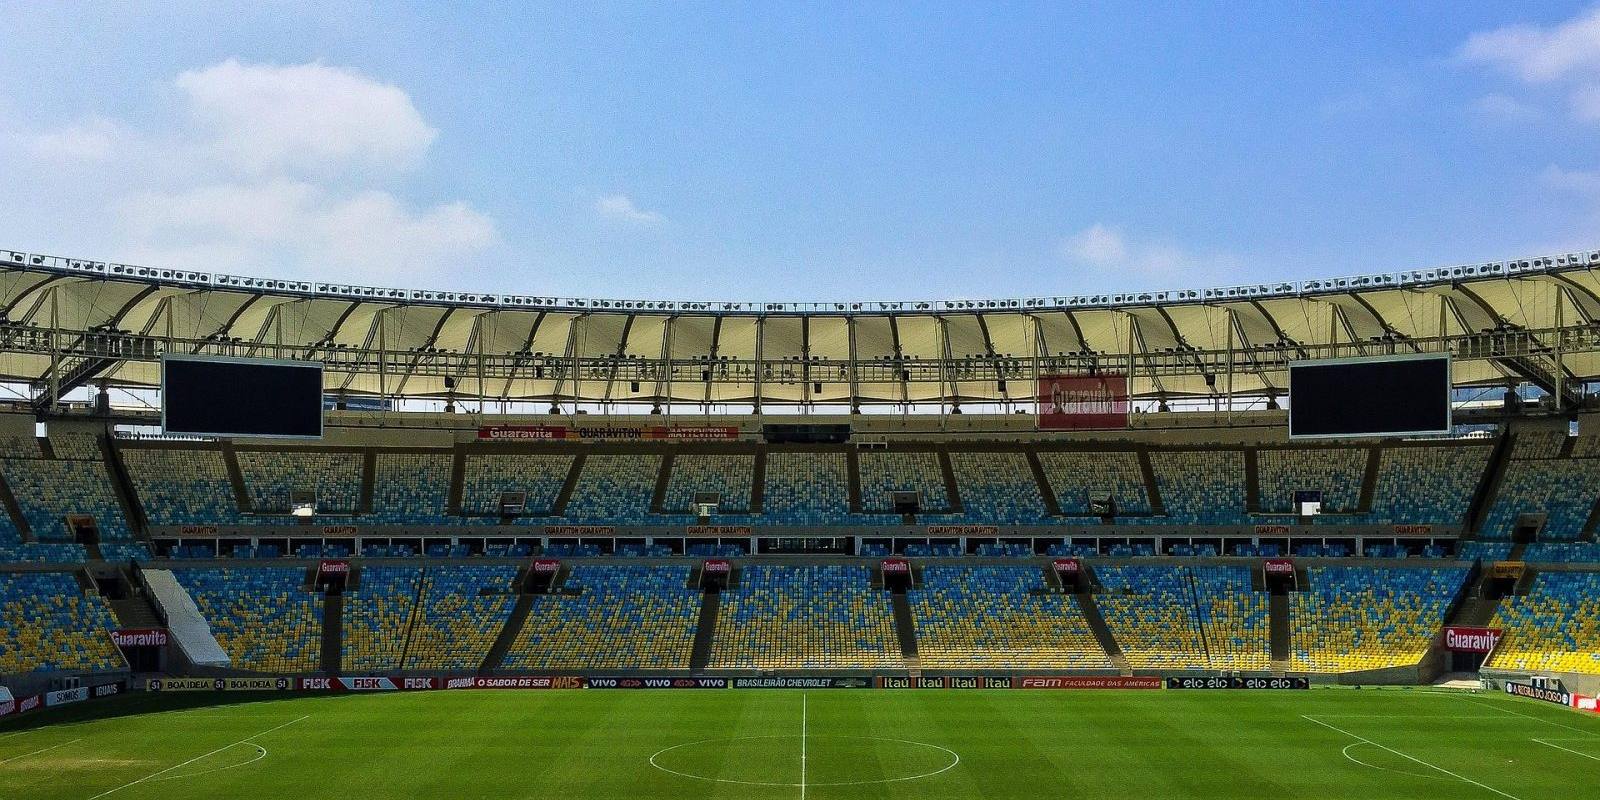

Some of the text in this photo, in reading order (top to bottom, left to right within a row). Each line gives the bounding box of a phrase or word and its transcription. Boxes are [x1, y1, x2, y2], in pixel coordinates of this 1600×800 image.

[490, 427, 553, 438] Guaravita
[579, 427, 642, 438] GUARAVITON
[112, 630, 167, 646] Guaravita
[168, 681, 209, 689] BOA IDEIA
[215, 680, 224, 689] 51
[231, 681, 248, 689] BOA
[277, 679, 286, 688] 51
[303, 678, 331, 689] FISK
[353, 678, 381, 689] FISK
[404, 678, 432, 689] FISK
[478, 677, 580, 689] O SABOR DE SER MAIS
[787, 678, 831, 687] CHEVROLET
[884, 677, 909, 688] Itaú
[917, 677, 943, 688] Itaú
[951, 677, 977, 688] Itaú
[984, 677, 1010, 688] Itaú
[1183, 678, 1203, 688] elo
[1207, 678, 1228, 688] elo
[1246, 678, 1267, 688] elo
[1270, 678, 1291, 688] elo
[96, 684, 118, 696] IGUAIS
[1518, 685, 1535, 697] REGRA
[1535, 688, 1544, 699] DO
[1544, 690, 1562, 702] JOGO
